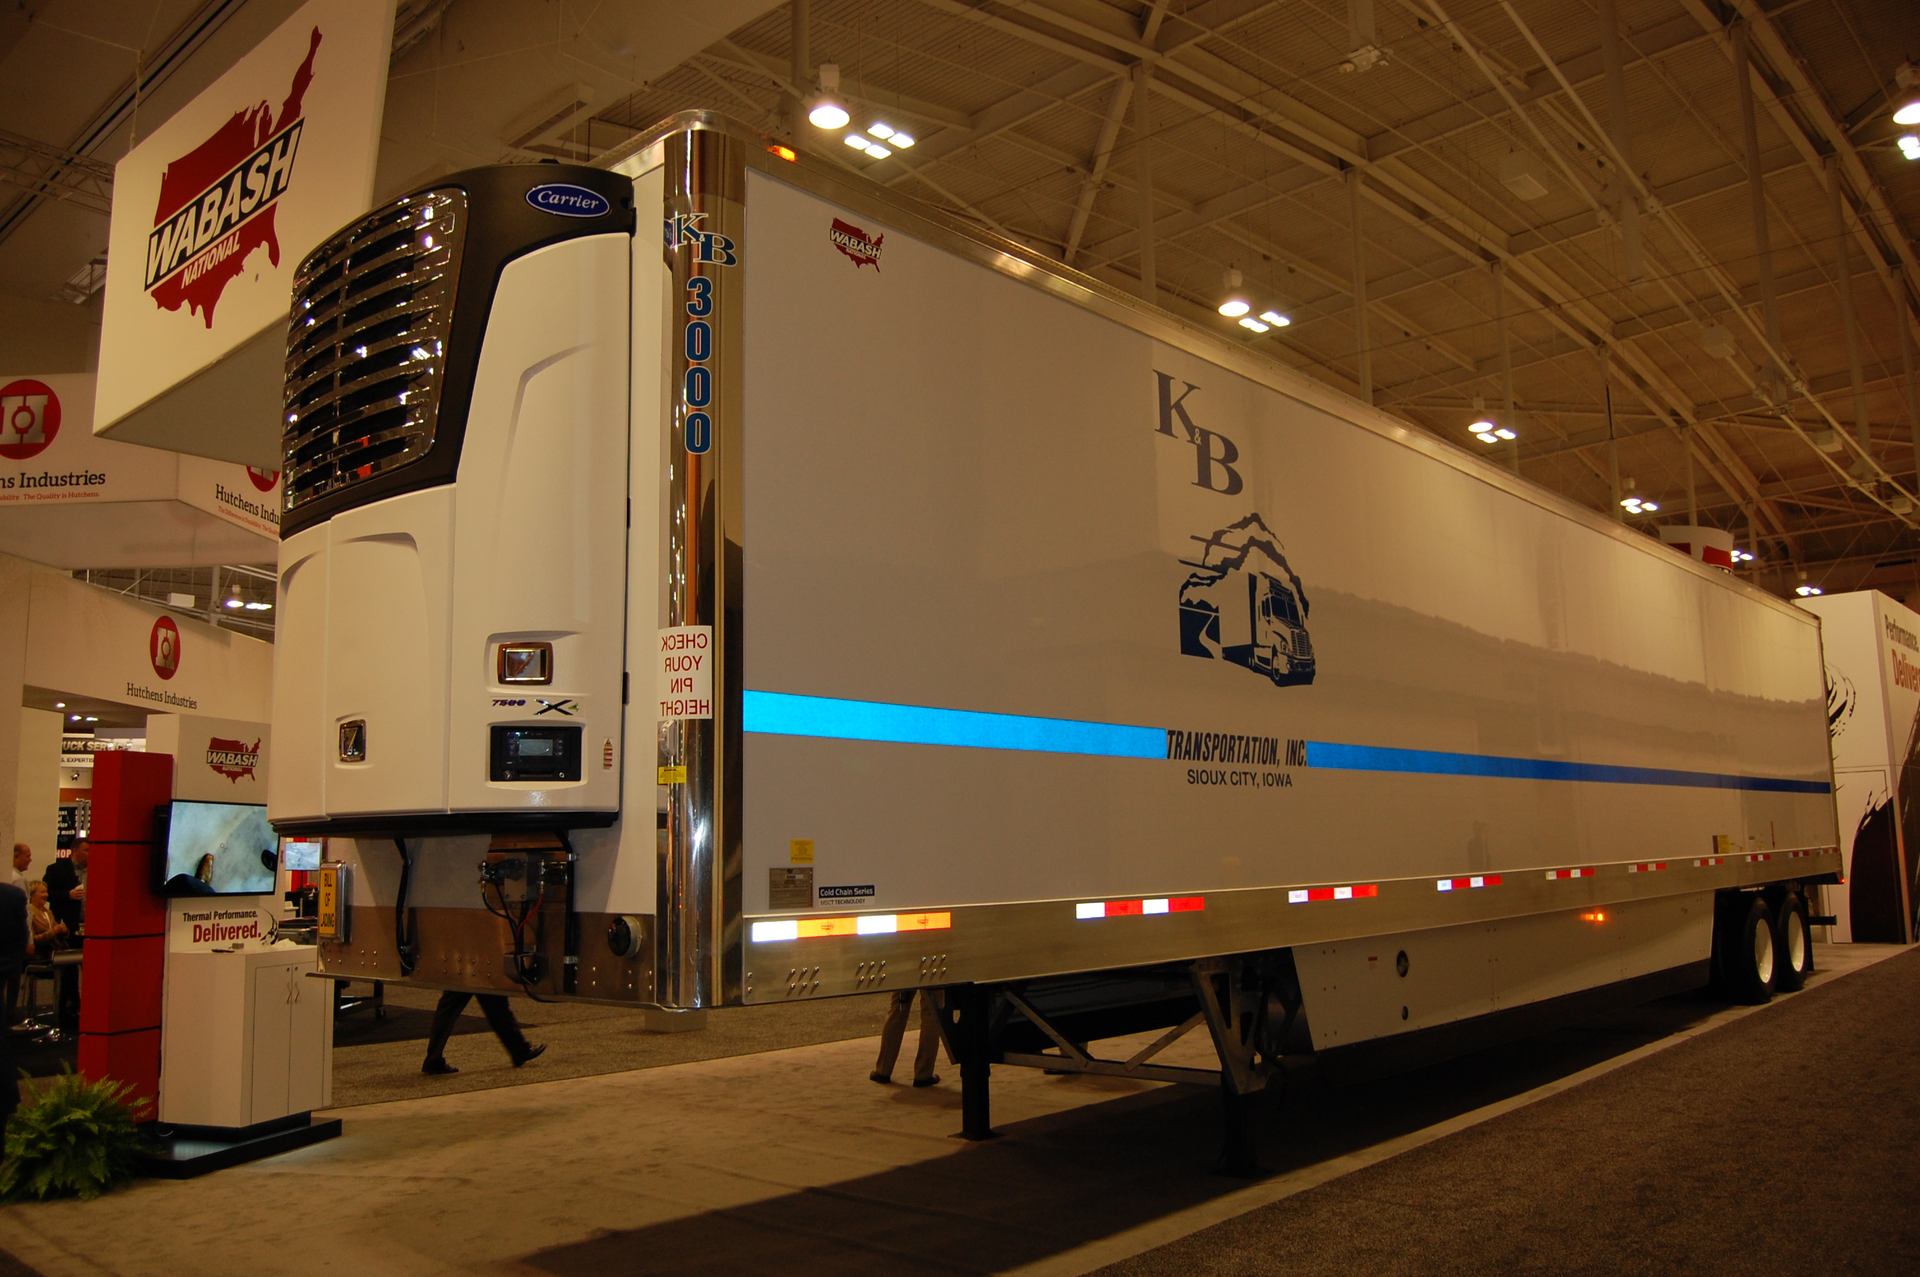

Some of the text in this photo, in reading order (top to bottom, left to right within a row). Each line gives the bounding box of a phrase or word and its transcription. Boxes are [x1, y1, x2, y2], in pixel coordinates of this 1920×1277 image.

[147, 128, 302, 286] WABASH
[537, 189, 600, 210] Carrier
[831, 229, 881, 258] WABASH
[181, 231, 240, 289] NATIONAL
[685, 276, 713, 455] 3000
[19, 470, 106, 488] Industries
[36, 491, 60, 500] Quality
[215, 483, 259, 516] Hutchens
[126, 682, 198, 710] Hutchens Industries
[62, 740, 85, 750] UCK
[1166, 729, 1308, 768] TRANSPORTATION, INC.
[207, 751, 258, 767] WABASH
[1187, 769, 1293, 790] SIOUX CITY, IOWA
[324, 873, 332, 888] BILL
[324, 892, 331, 907] OF
[820, 887, 874, 897] Cold Chain Series
[183, 909, 258, 922] Thermal Performance.
[320, 913, 335, 927] LADING
[192, 920, 262, 943] Delivered.
